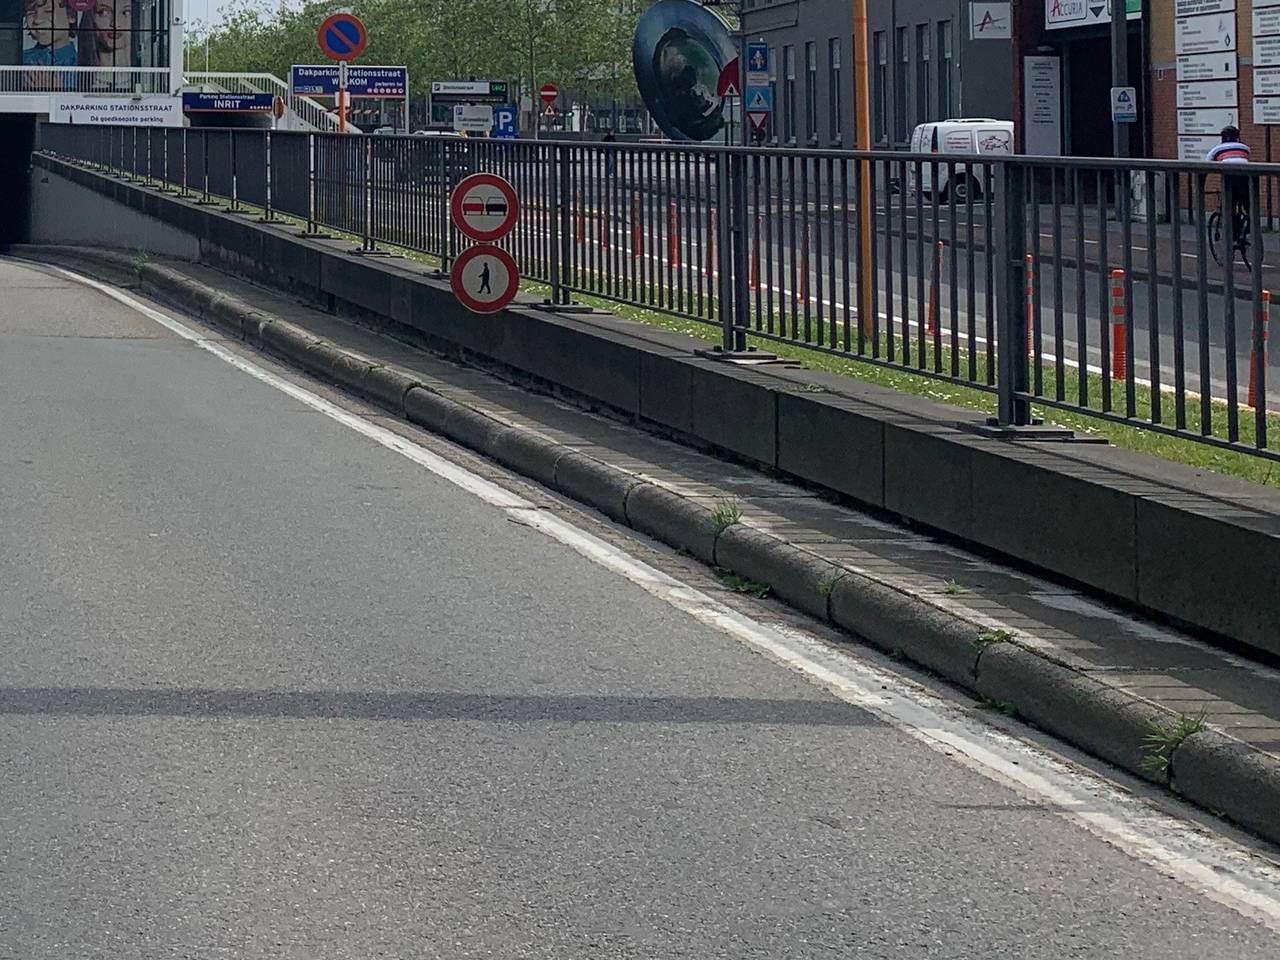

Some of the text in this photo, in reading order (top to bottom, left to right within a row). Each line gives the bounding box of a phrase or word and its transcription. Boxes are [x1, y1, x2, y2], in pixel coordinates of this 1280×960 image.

[331, 78, 368, 86] WKOM
[109, 104, 173, 112] STATIONSSTRAAT
[214, 100, 241, 109] INRIT
[498, 111, 513, 130] P
